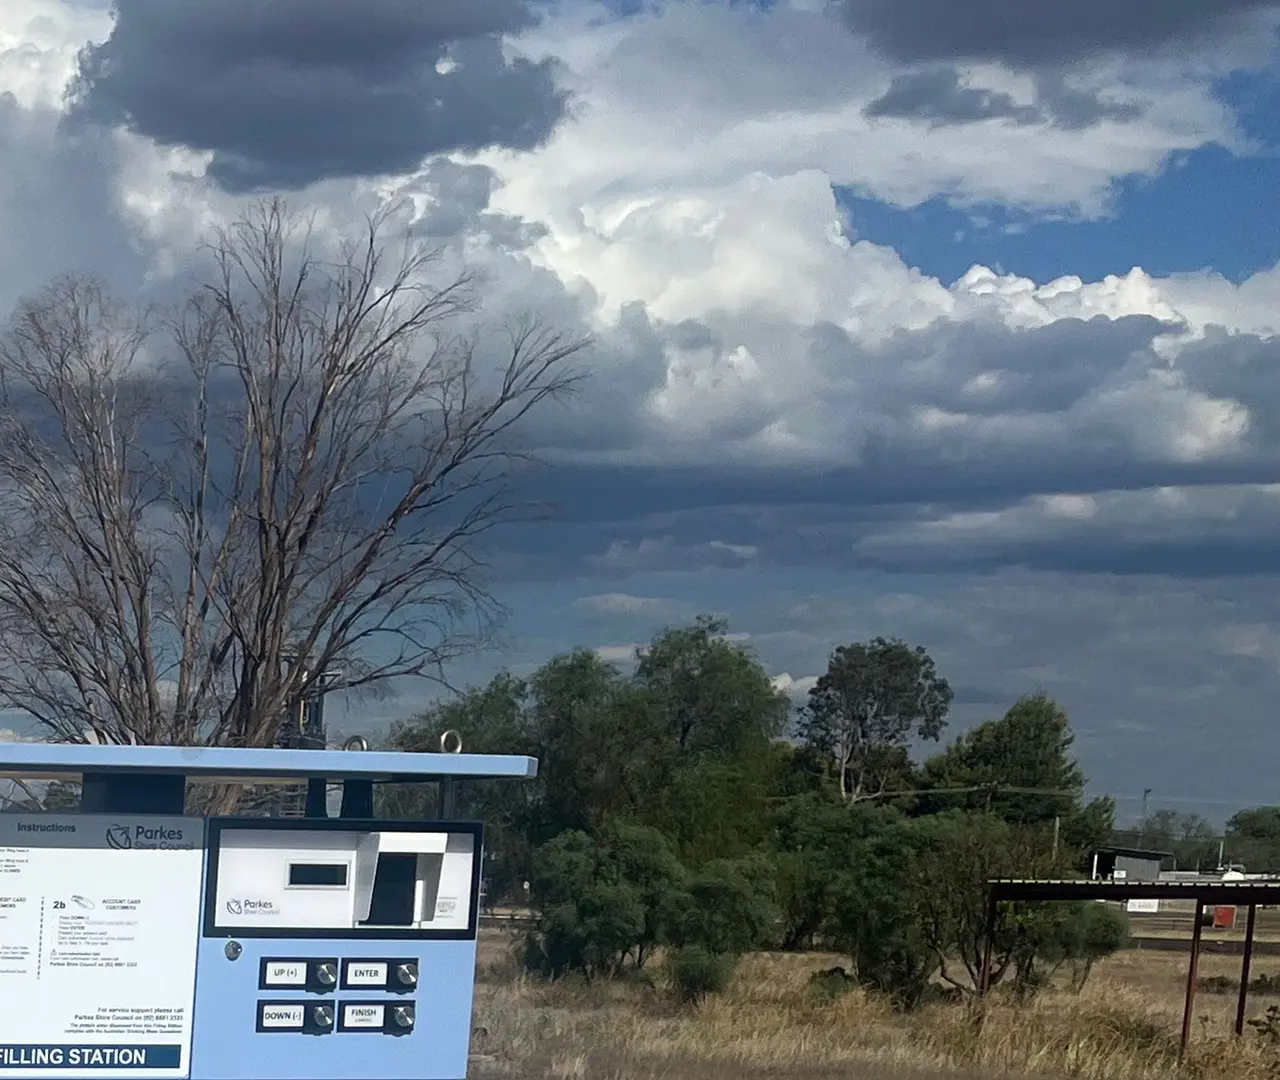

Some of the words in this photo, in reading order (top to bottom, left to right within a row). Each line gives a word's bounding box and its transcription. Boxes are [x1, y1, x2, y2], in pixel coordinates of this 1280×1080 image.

[17, 822, 77, 833] Instructions
[135, 825, 183, 840] Parkes
[134, 841, 157, 850] Shire
[159, 841, 194, 851] Council
[53, 901, 66, 909] 2b
[244, 899, 274, 908] Parkes
[274, 968, 285, 976] UP
[287, 967, 297, 978] (+)
[354, 969, 379, 977] ENTER
[264, 1012, 291, 1020] DOWN
[292, 1012, 302, 1021] (-)
[351, 1008, 377, 1016] FINISH
[68, 1048, 146, 1065] STATION
